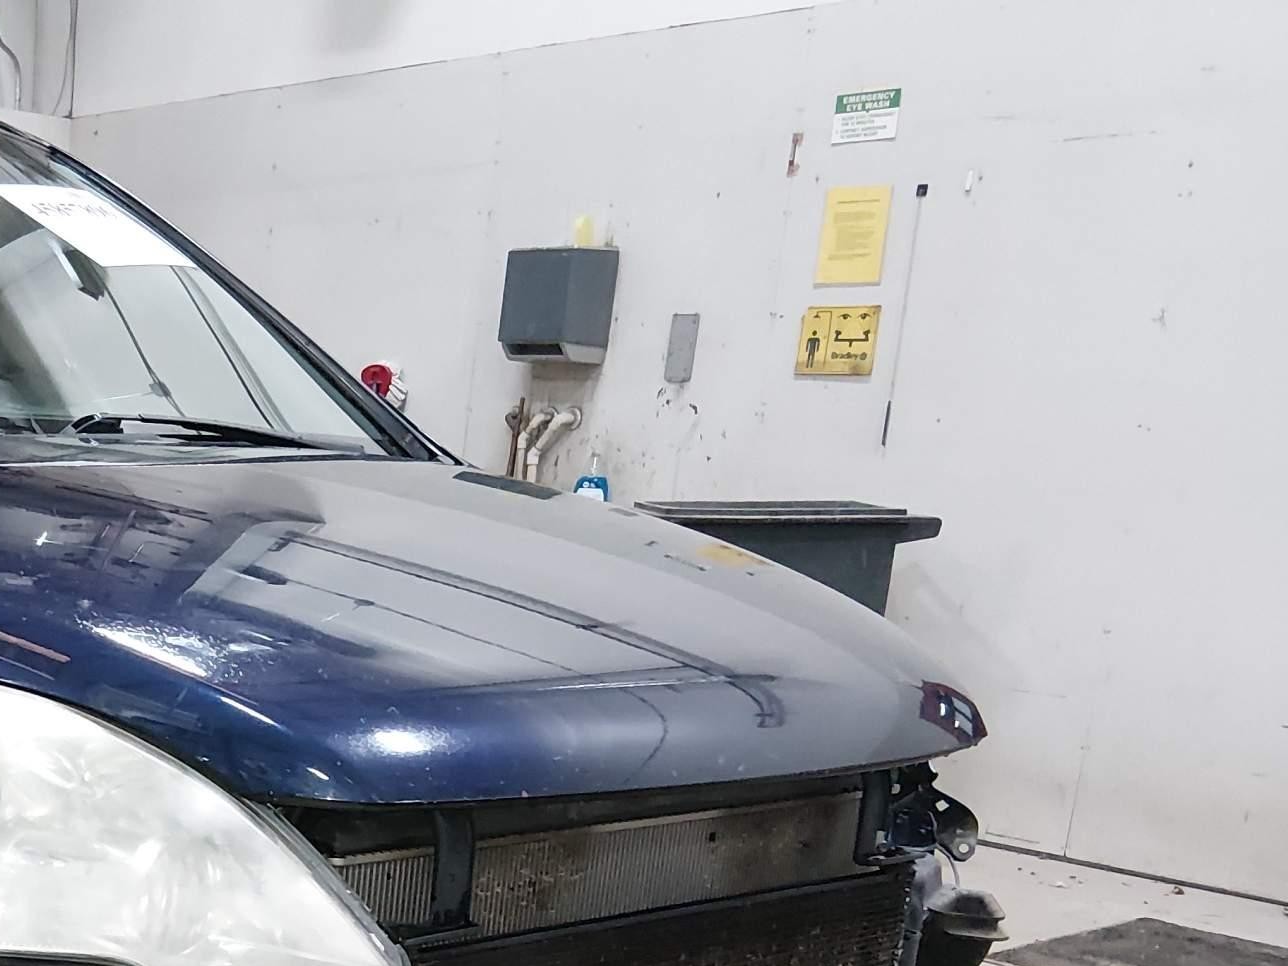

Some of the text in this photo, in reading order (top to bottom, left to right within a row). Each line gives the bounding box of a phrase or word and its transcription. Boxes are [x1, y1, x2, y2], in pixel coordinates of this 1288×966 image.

[842, 90, 896, 104] EMERGENCY
[846, 100, 890, 112] EYE WASH
[831, 351, 858, 361] Bradley
